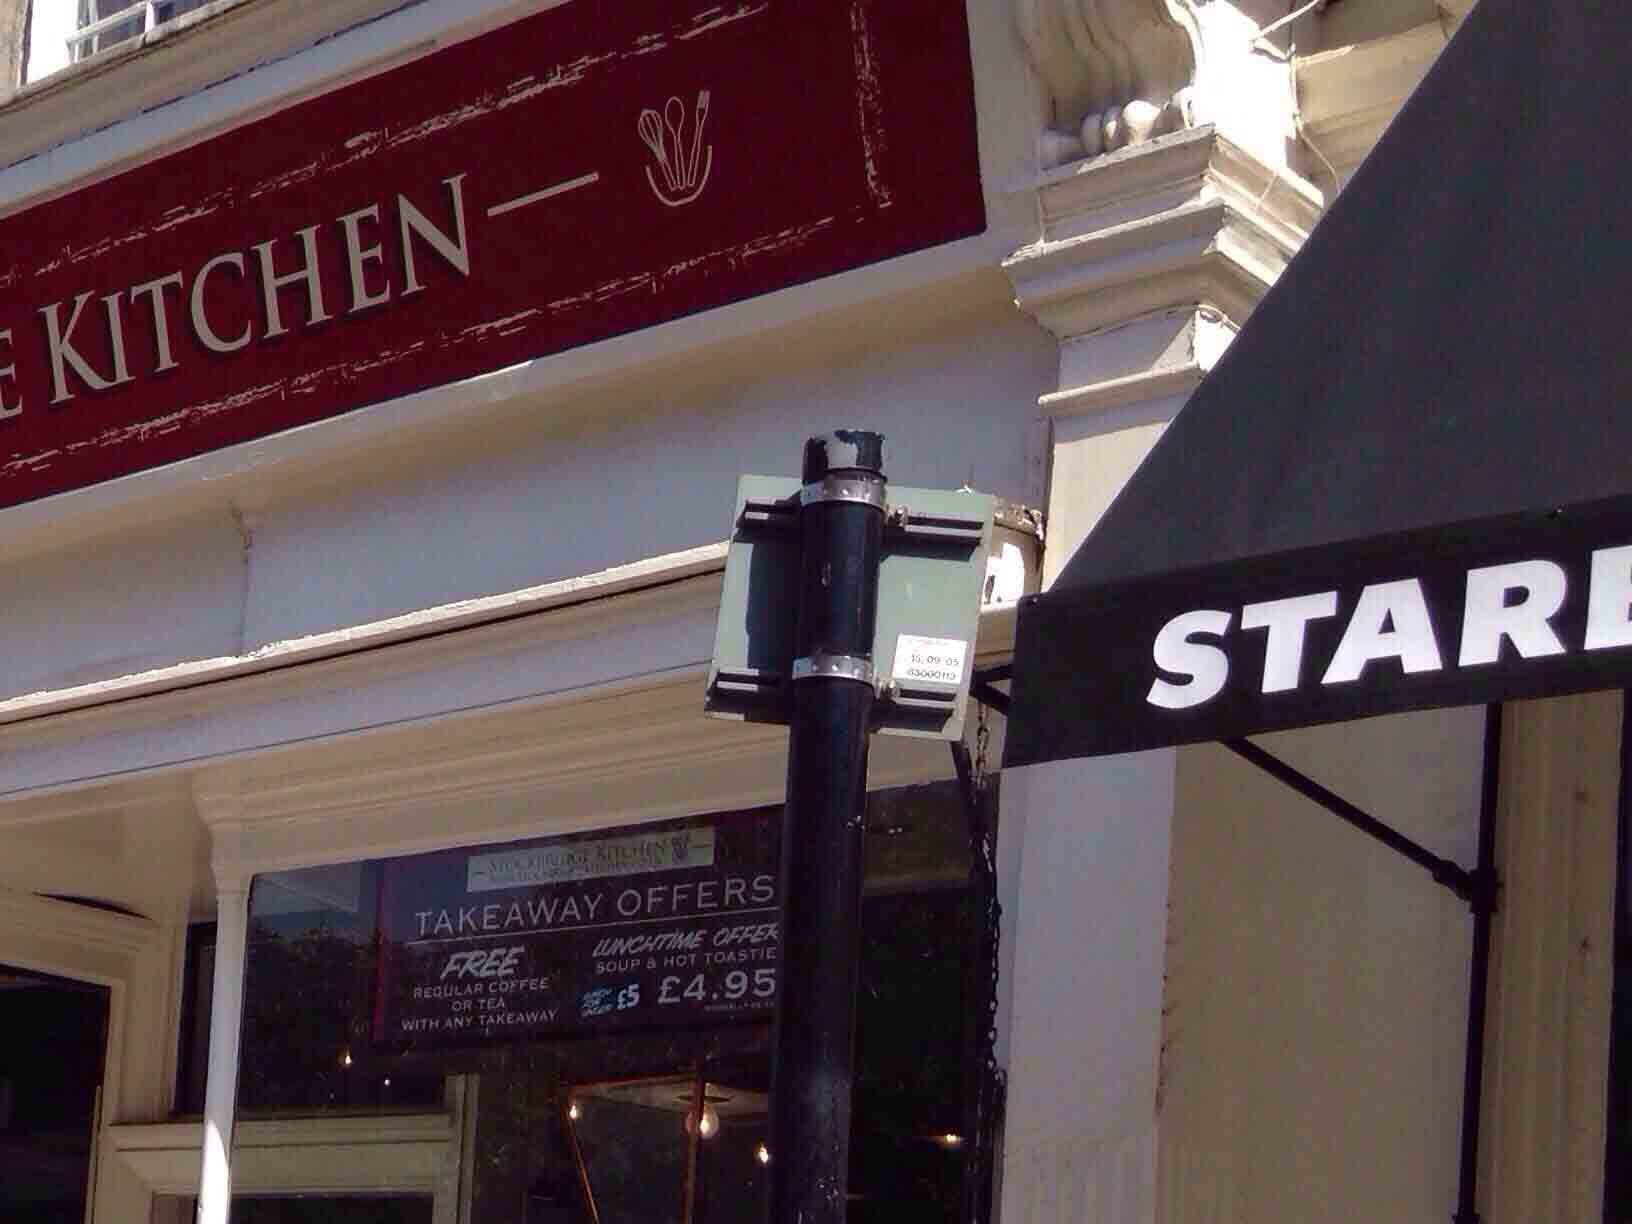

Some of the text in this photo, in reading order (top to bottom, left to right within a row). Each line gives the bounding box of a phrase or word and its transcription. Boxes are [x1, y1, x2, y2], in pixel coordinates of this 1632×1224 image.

[45, 173, 476, 407] KITCHEN
[415, 874, 777, 938] TAKEAWAY OFFERS
[592, 921, 779, 958] LUNCHTIME OFFER
[439, 945, 526, 982] FREE
[596, 958, 641, 976] SOUP
[663, 953, 696, 969] HOT
[703, 946, 777, 965] TOASTIE
[413, 976, 551, 1000] REGULAR COFFEE
[451, 996, 506, 1013] OR TEA
[656, 967, 777, 1006] £4.95
[401, 1006, 560, 1032] WITH ANY TAKEAWAY
